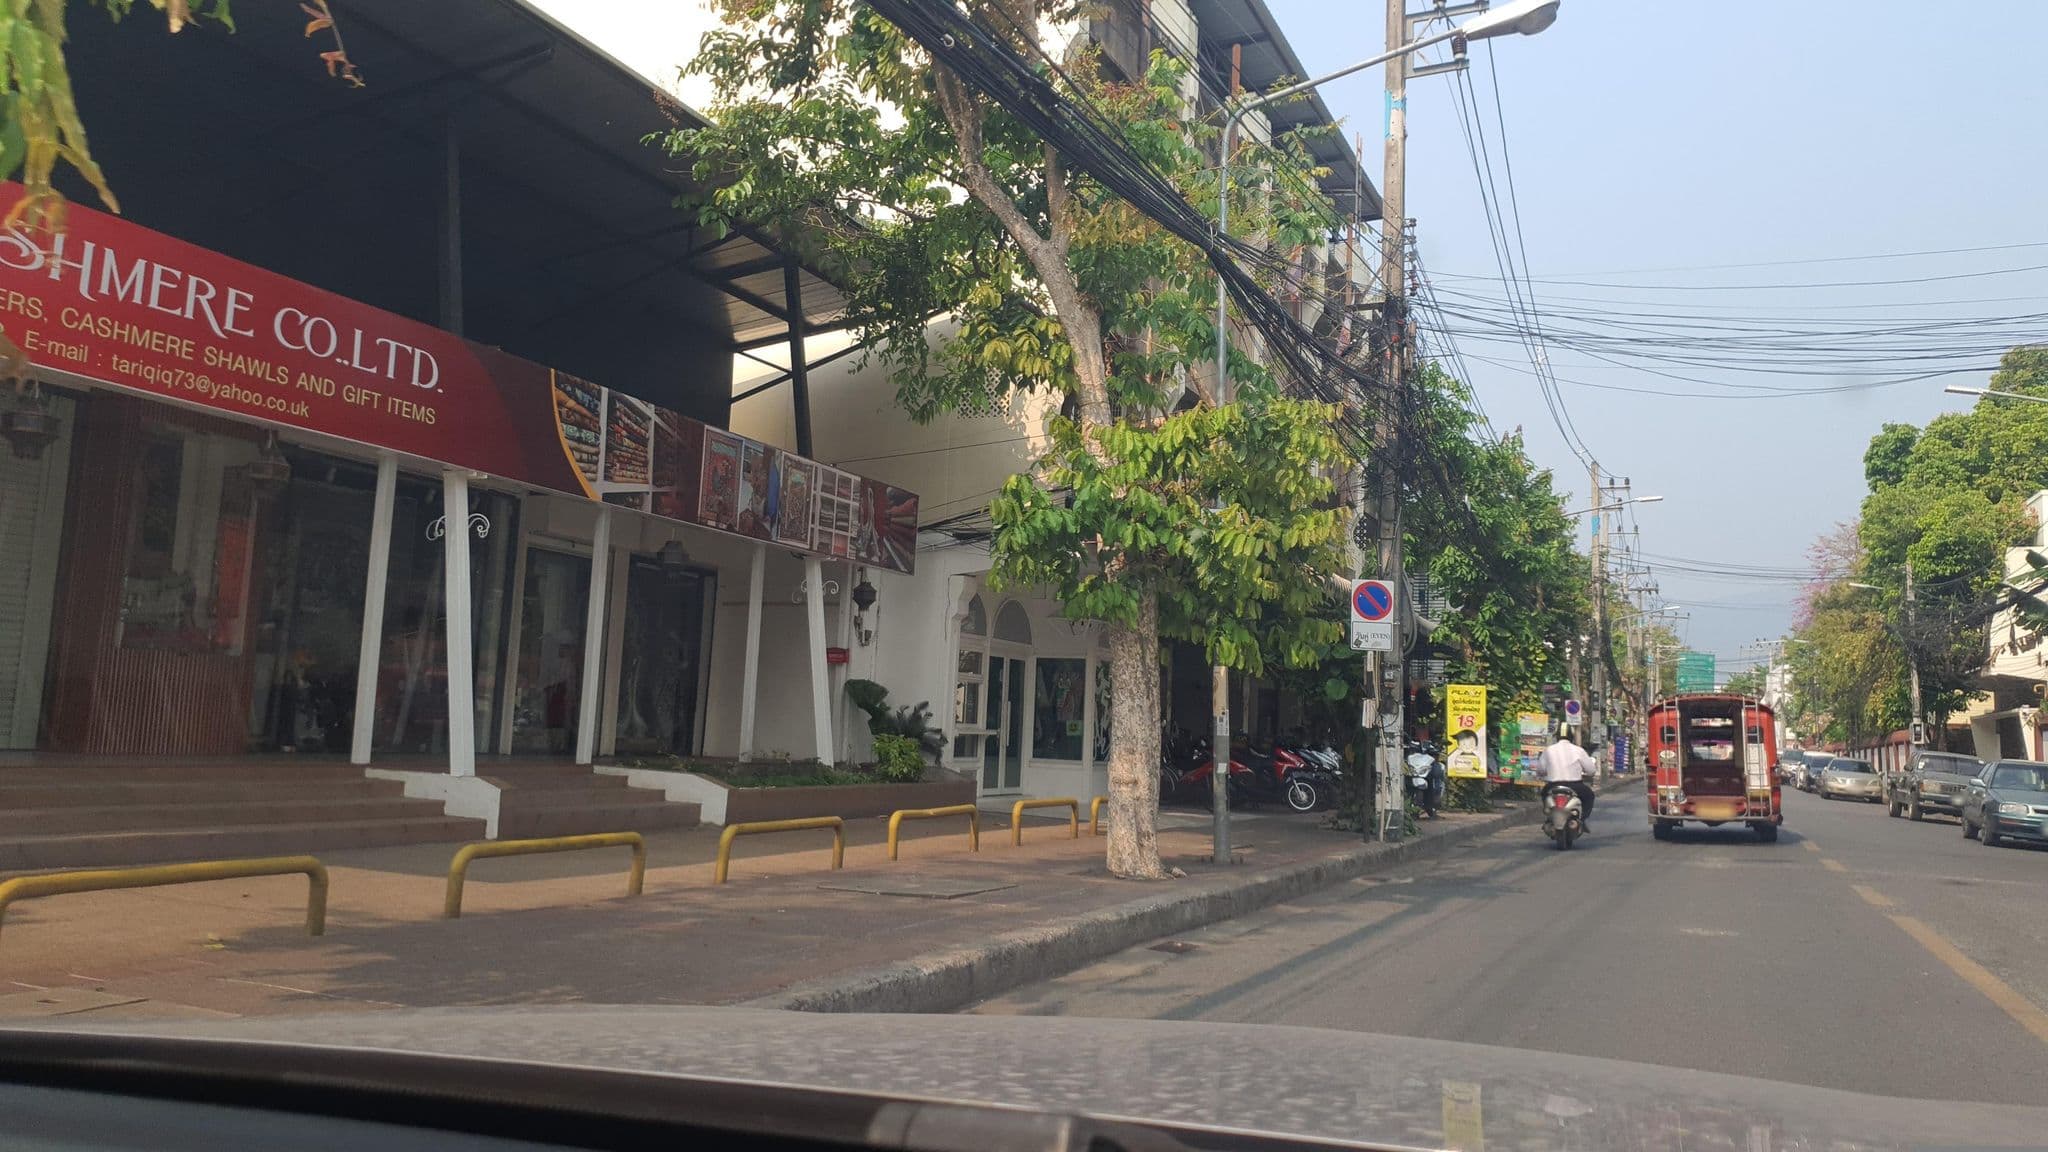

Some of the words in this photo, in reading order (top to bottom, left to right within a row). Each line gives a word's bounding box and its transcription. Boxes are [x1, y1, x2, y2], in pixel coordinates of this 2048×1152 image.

[24, 329, 89, 363] E-mail
[111, 353, 310, 418] tariqiq73@yahoo.co.uk
[60, 307, 196, 361] CASHMERE
[203, 346, 290, 385] SHAWLS
[295, 372, 336, 397] AND
[342, 384, 382, 409] GIFT
[387, 396, 436, 425] ITEMS
[1457, 714, 1475, 728] 18
